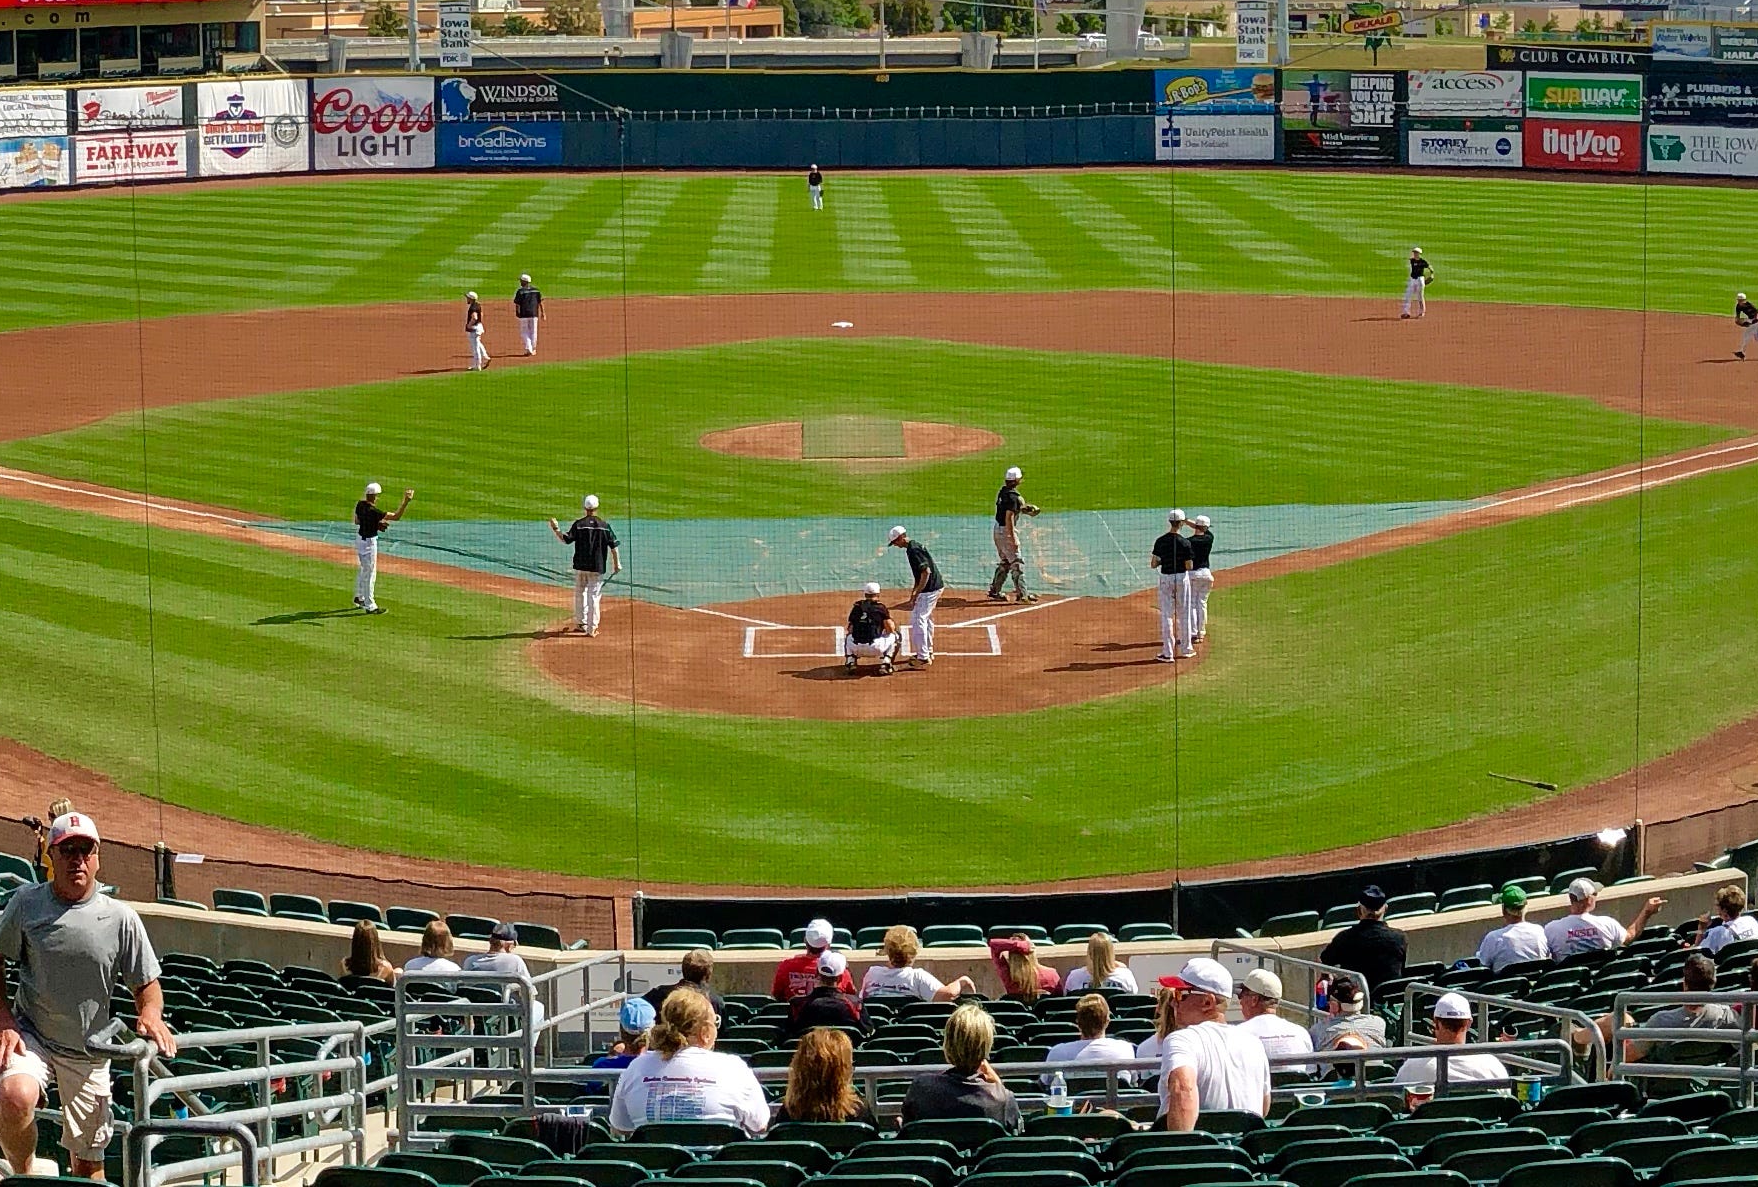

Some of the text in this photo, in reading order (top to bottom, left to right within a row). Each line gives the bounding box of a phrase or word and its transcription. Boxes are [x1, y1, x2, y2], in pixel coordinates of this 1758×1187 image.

[441, 18, 469, 28] Iowa
[1238, 15, 1266, 24] Iowa
[1353, 16, 1394, 30] DEKALB
[441, 28, 470, 38] State
[1238, 25, 1266, 35] State
[441, 38, 470, 48] Bank
[1238, 35, 1266, 45] Bank
[1519, 50, 1636, 64] CLUB CAMBRIA
[1350, 77, 1394, 90] HELPING
[1431, 76, 1498, 90] access
[1687, 84, 1752, 95] PLUMBERS &
[479, 85, 559, 102] WINDSOR
[1350, 91, 1394, 102] YOU STAY
[1545, 86, 1630, 106] SUBWAY
[314, 88, 435, 134] Coors
[1350, 103, 1394, 124] SAFE
[221, 134, 248, 145] PULLED
[337, 134, 416, 157] LIGHT
[458, 131, 547, 148] broadlawns
[1421, 138, 1468, 147] STOREY
[1691, 135, 1720, 149] THE
[86, 142, 178, 161] FAREWAY
[1421, 147, 1490, 155] KENWORTHY
[1691, 149, 1746, 165] CLINIC
